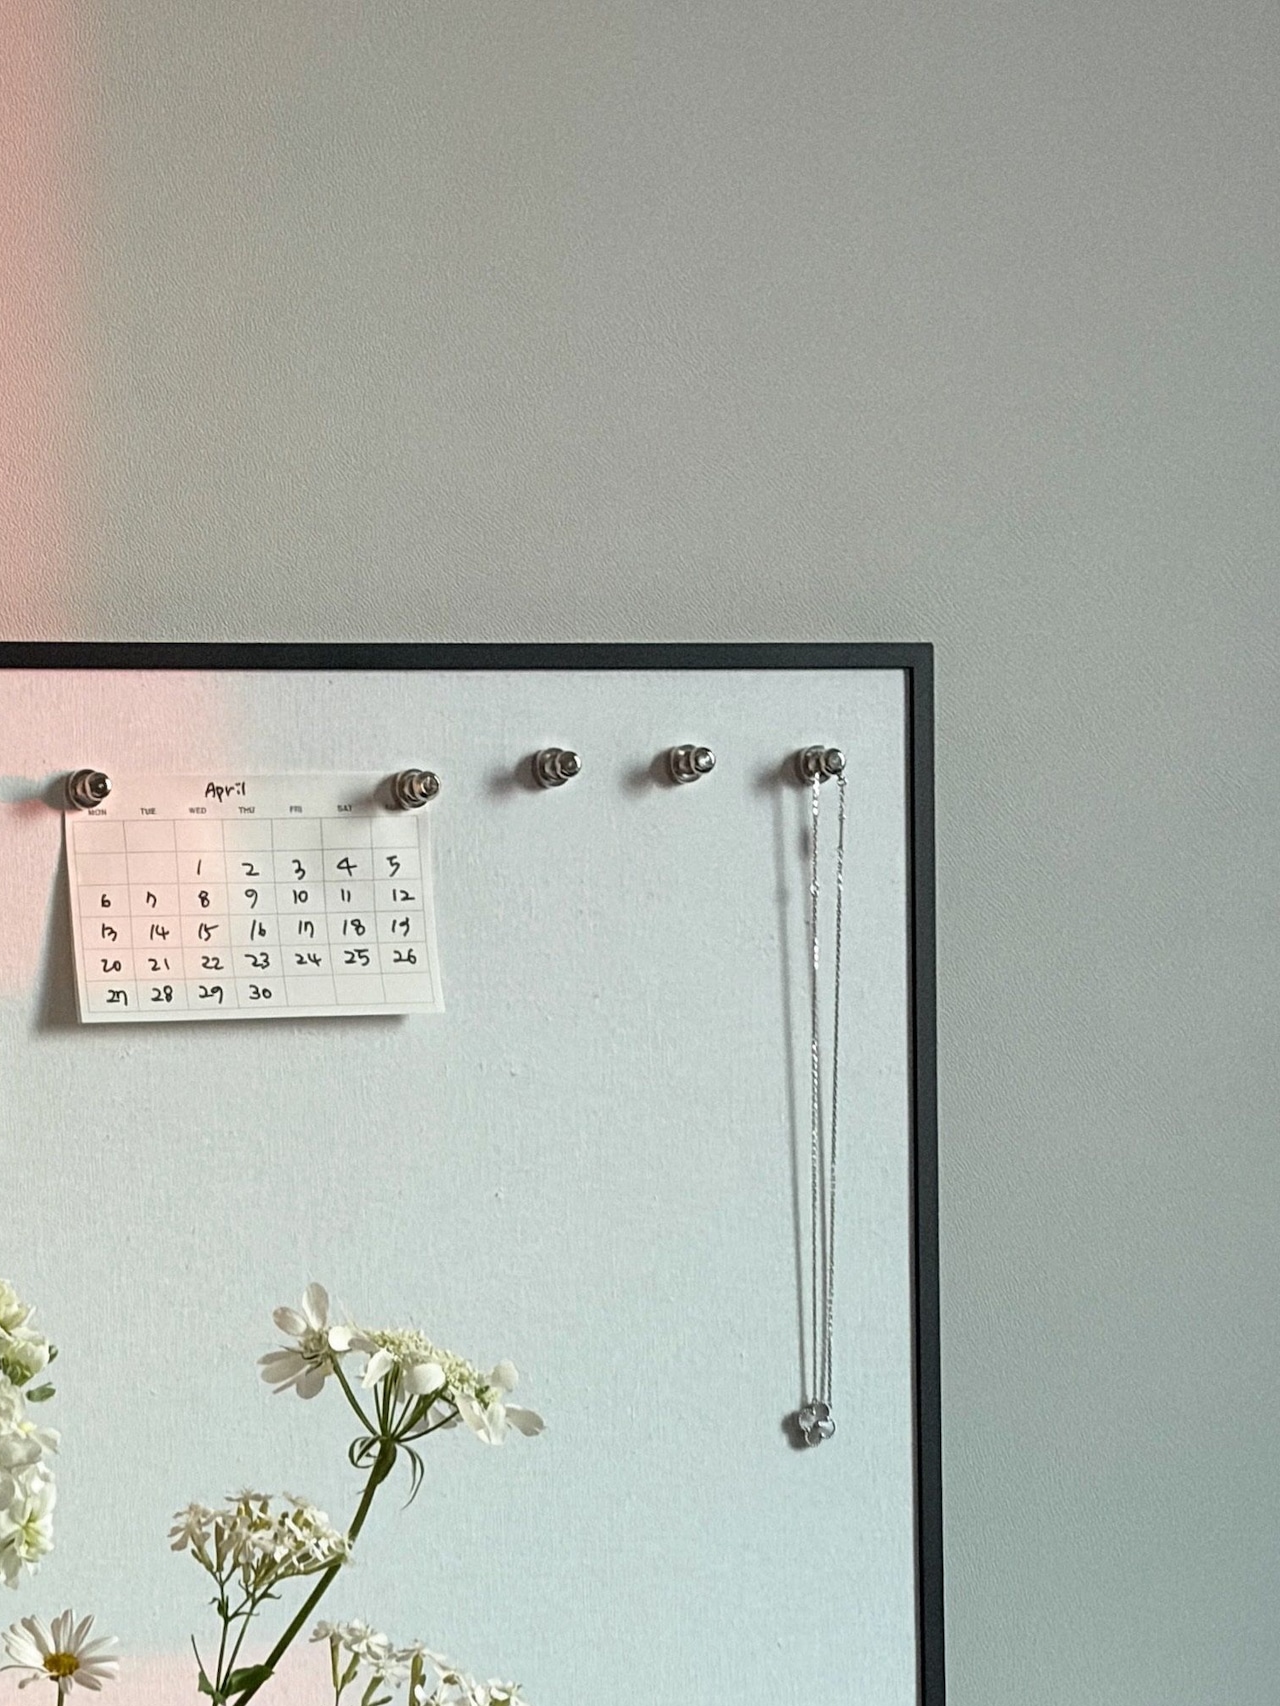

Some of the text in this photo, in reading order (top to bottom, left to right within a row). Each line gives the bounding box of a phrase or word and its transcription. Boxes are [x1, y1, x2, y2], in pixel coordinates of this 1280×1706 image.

[204, 781, 246, 804] April
[88, 804, 352, 816] MON TUE WED THU FRI SAT
[196, 854, 402, 882] 1 2 3 4 5
[99, 893, 112, 910] 6
[197, 889, 211, 909] 8
[243, 888, 260, 910] 9
[292, 888, 309, 905] 10
[339, 888, 353, 904] 11
[391, 888, 417, 903] 12
[100, 916, 411, 943] 13 14 15 16 17 18 19
[100, 947, 418, 974] 20 21 22 23 24 25 26
[105, 983, 274, 1008] 27 28 29 30
